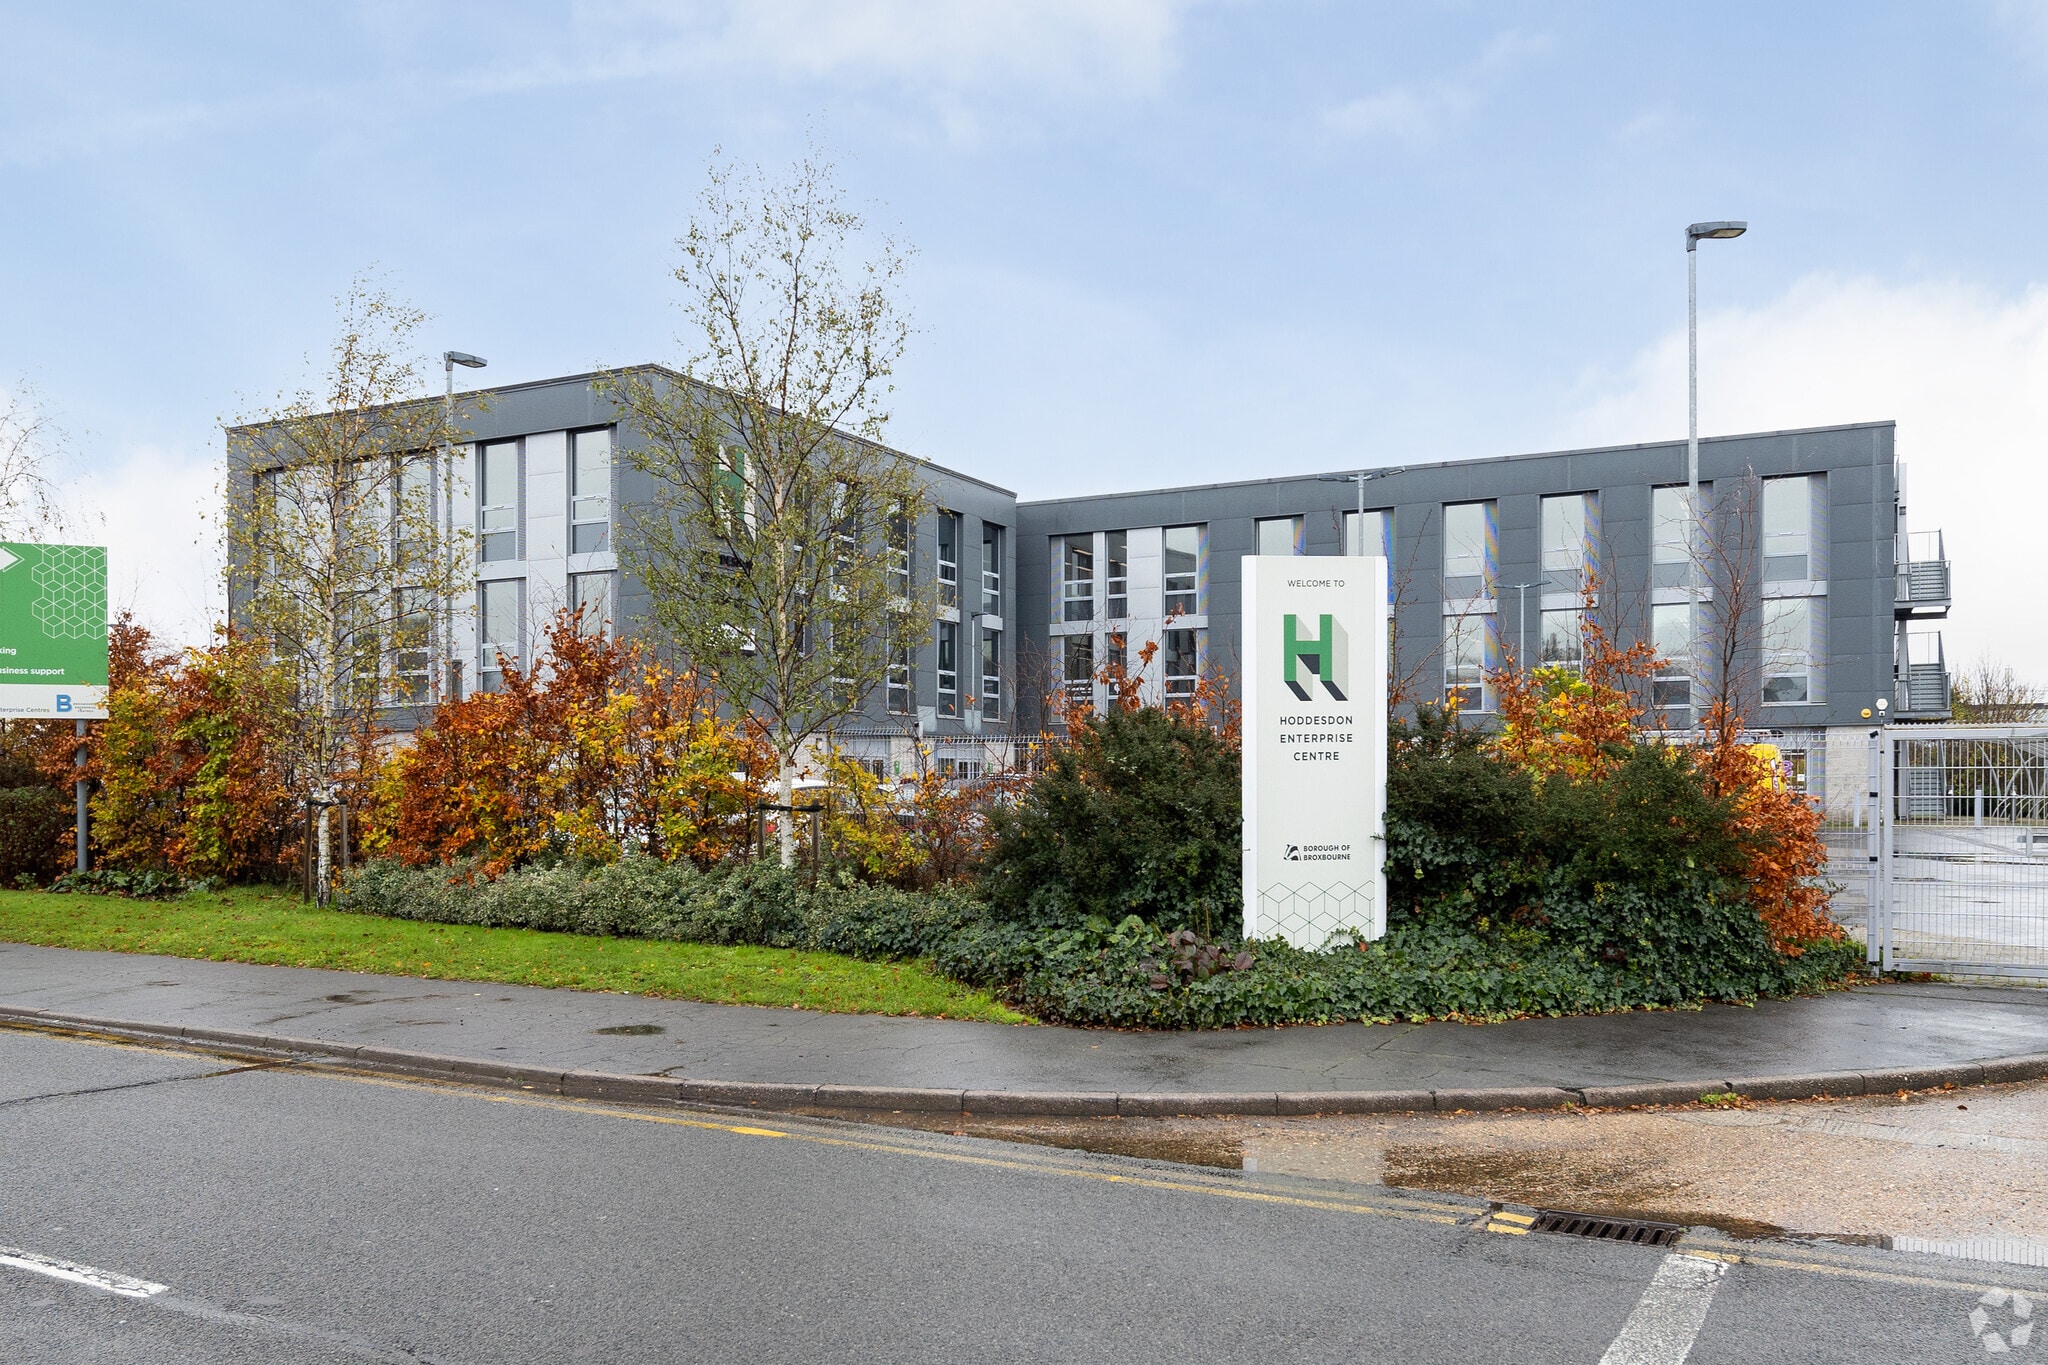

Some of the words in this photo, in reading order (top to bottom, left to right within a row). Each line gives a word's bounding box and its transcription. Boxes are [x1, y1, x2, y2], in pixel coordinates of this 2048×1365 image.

[1287, 579, 1331, 588] WELCOME
[1333, 579, 1345, 588] TO
[1283, 614, 1349, 701] H
[56, 694, 72, 712] B
[1280, 716, 1353, 726] HODDESDON
[1280, 734, 1353, 744] ENTERPRISE
[1293, 751, 1340, 762] CENTRE
